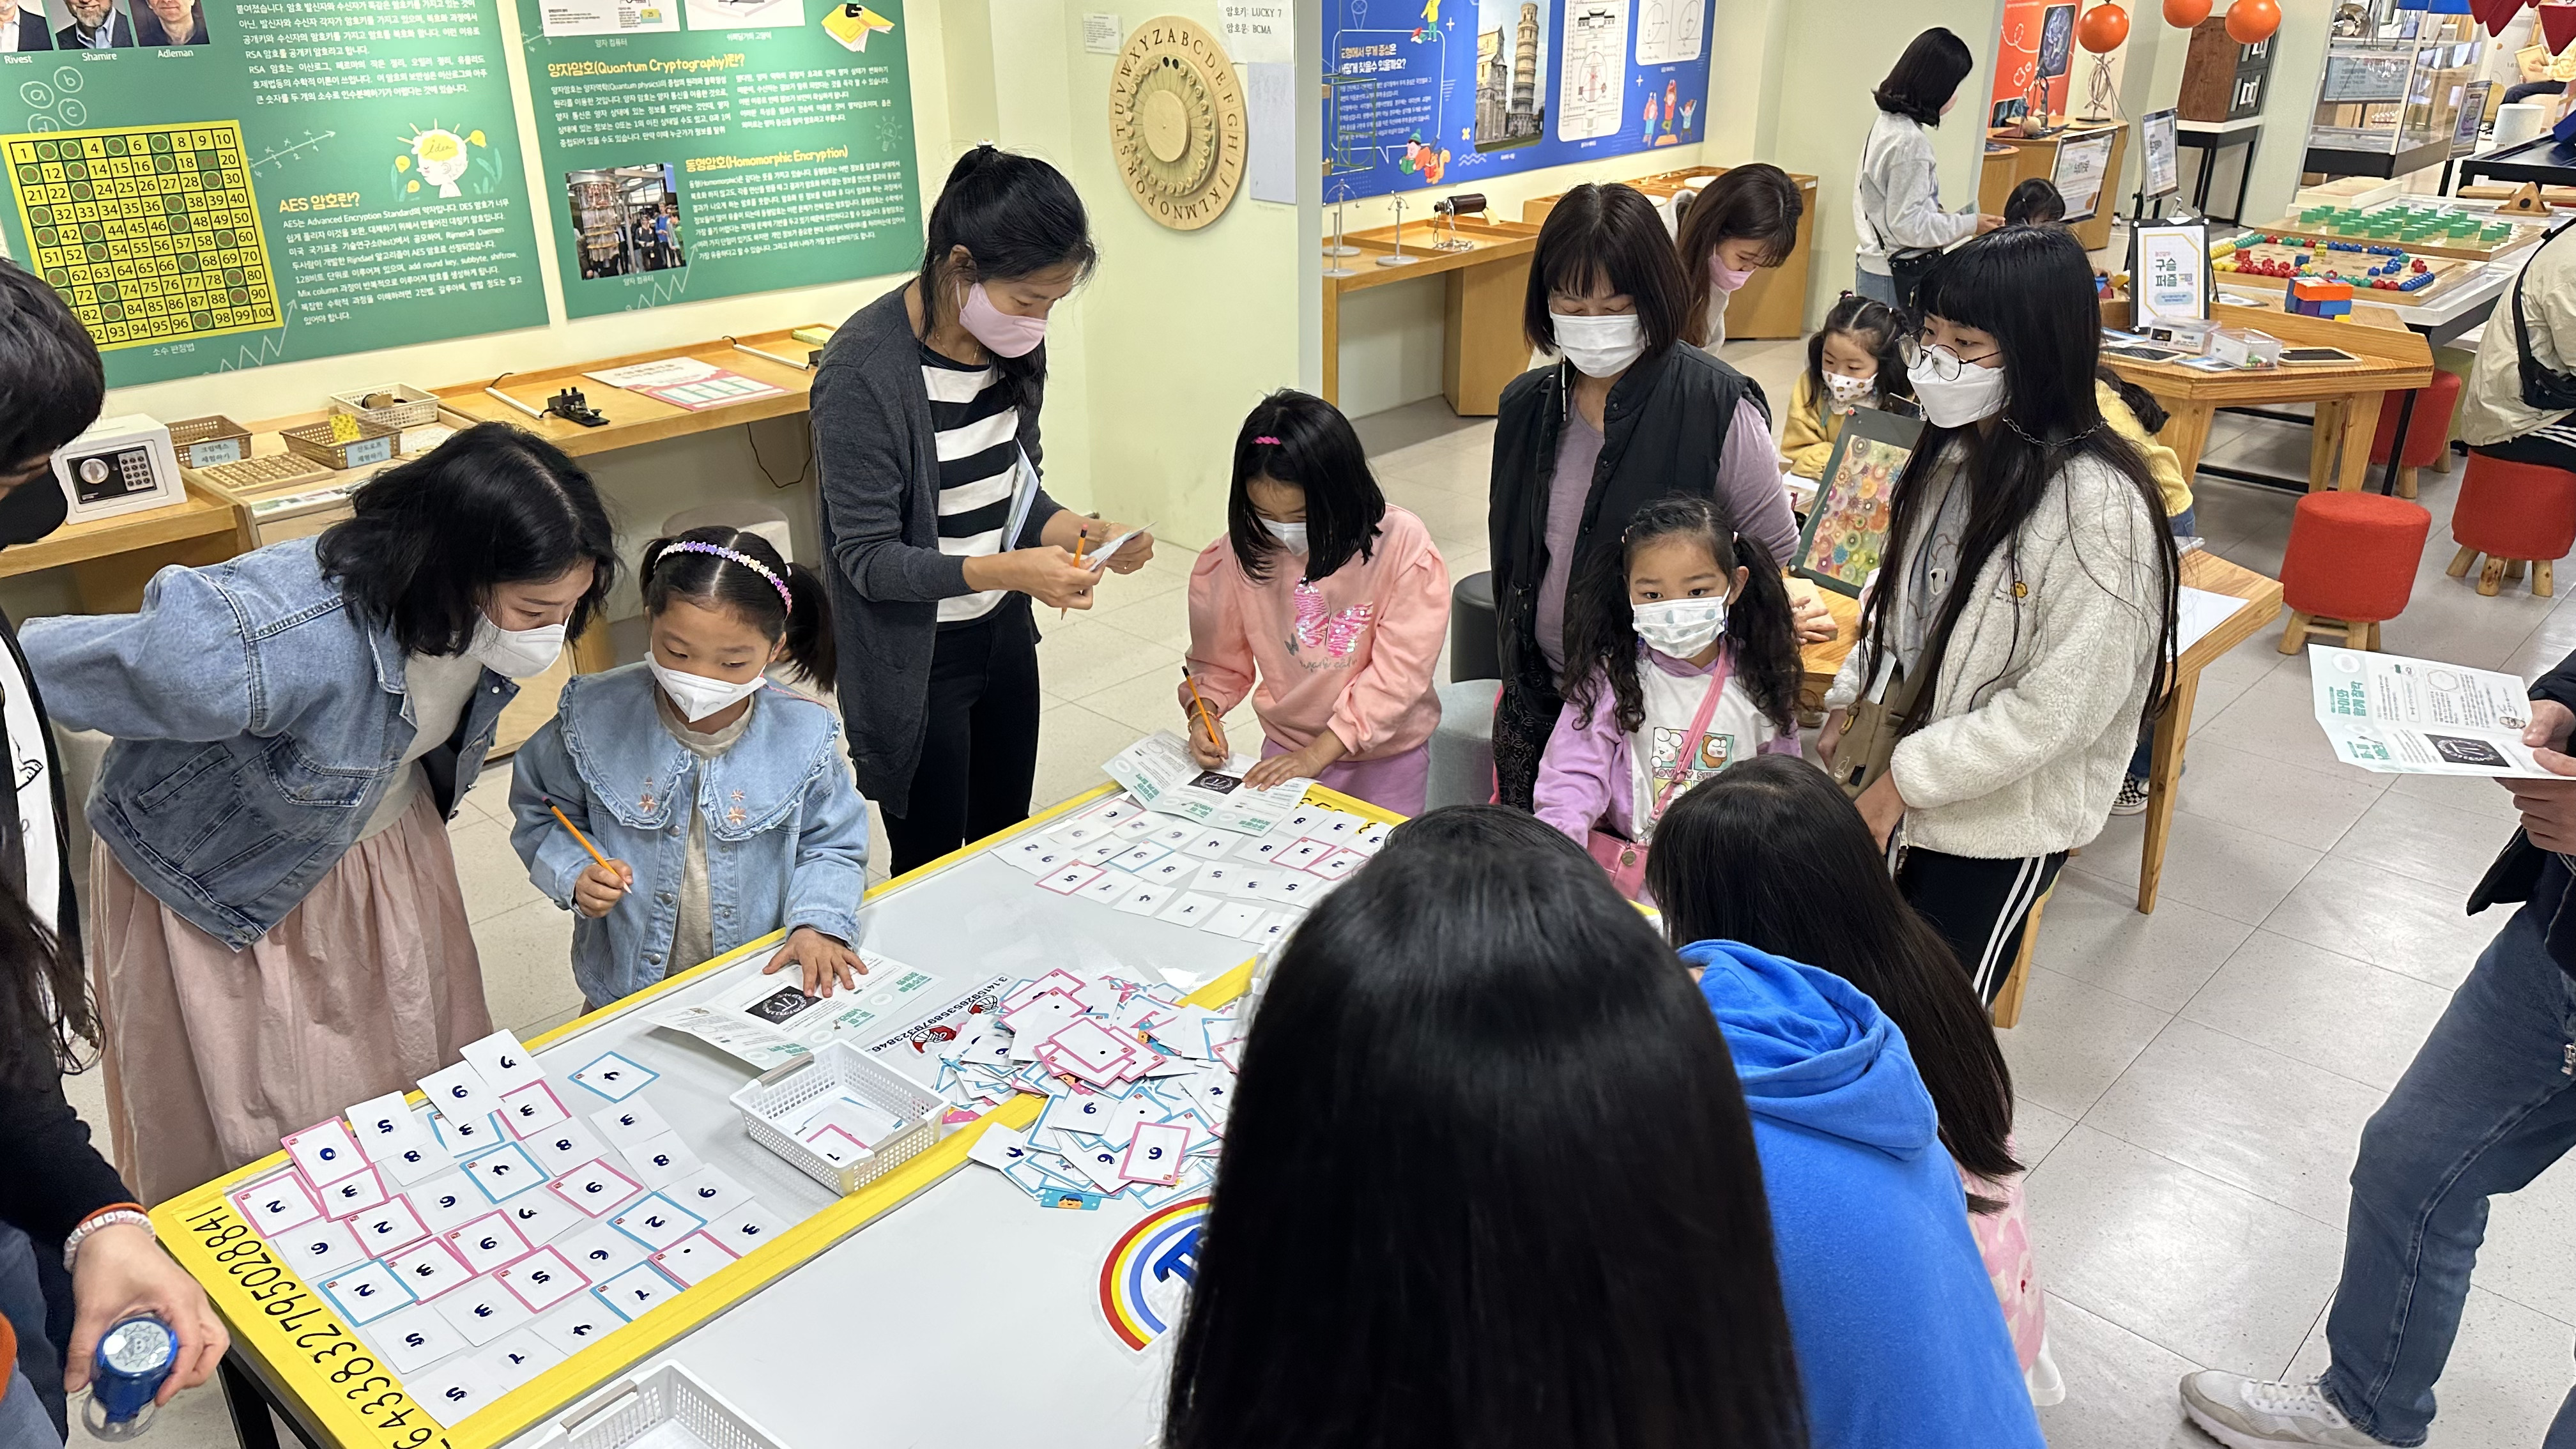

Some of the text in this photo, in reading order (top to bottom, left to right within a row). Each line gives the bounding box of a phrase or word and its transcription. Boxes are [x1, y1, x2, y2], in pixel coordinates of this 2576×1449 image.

[287, 3, 303, 13] 암호
[1252, 8, 1275, 17] LUCKY
[1278, 9, 1282, 17] 7
[260, 19, 291, 29] 발신자와
[295, 18, 318, 27] 수신자
[319, 17, 342, 26] 각자가
[243, 34, 274, 45] 공개키와
[277, 33, 308, 43] 수신자의
[609, 38, 627, 47] 컴퓨터
[4, 55, 33, 64] Rivest
[82, 52, 118, 61] Shamire
[157, 49, 194, 58] Adleman
[245, 50, 262, 59] RSA
[289, 47, 312, 58] 공개키
[313, 47, 344, 57] 암호라고
[249, 65, 266, 73] RSA
[270, 64, 294, 74] 암호는
[548, 53, 745, 78] 양자암호(Quantum Cryptography)란?
[91, 134, 231, 153] 4 6 8 9 10
[424, 139, 454, 156] idea
[793, 144, 848, 163] Encryption)
[45, 154, 236, 180] 12 14 16 18 20
[27, 173, 240, 201] 21 22 24 27 30
[55, 193, 245, 220] 32 33 39 40
[279, 192, 360, 213] AES 암호란?
[283, 219, 305, 228] AES는
[307, 215, 342, 226] Advanced
[344, 212, 382, 223] Encryption
[459, 202, 473, 211] DES
[44, 231, 253, 263] 51 52 60
[289, 247, 304, 256] 미국
[95, 251, 257, 279] 63 69 70
[2156, 257, 2177, 272] 구슬
[77, 270, 261, 301] 72 80
[295, 273, 325, 284] 128비트
[2156, 273, 2177, 288] 퍼즐
[126, 288, 266, 315] 84 90
[109, 307, 273, 337] 93 99 100
[153, 343, 195, 356] 소수 판정법
[1148, 1147, 1163, 1160] 9
